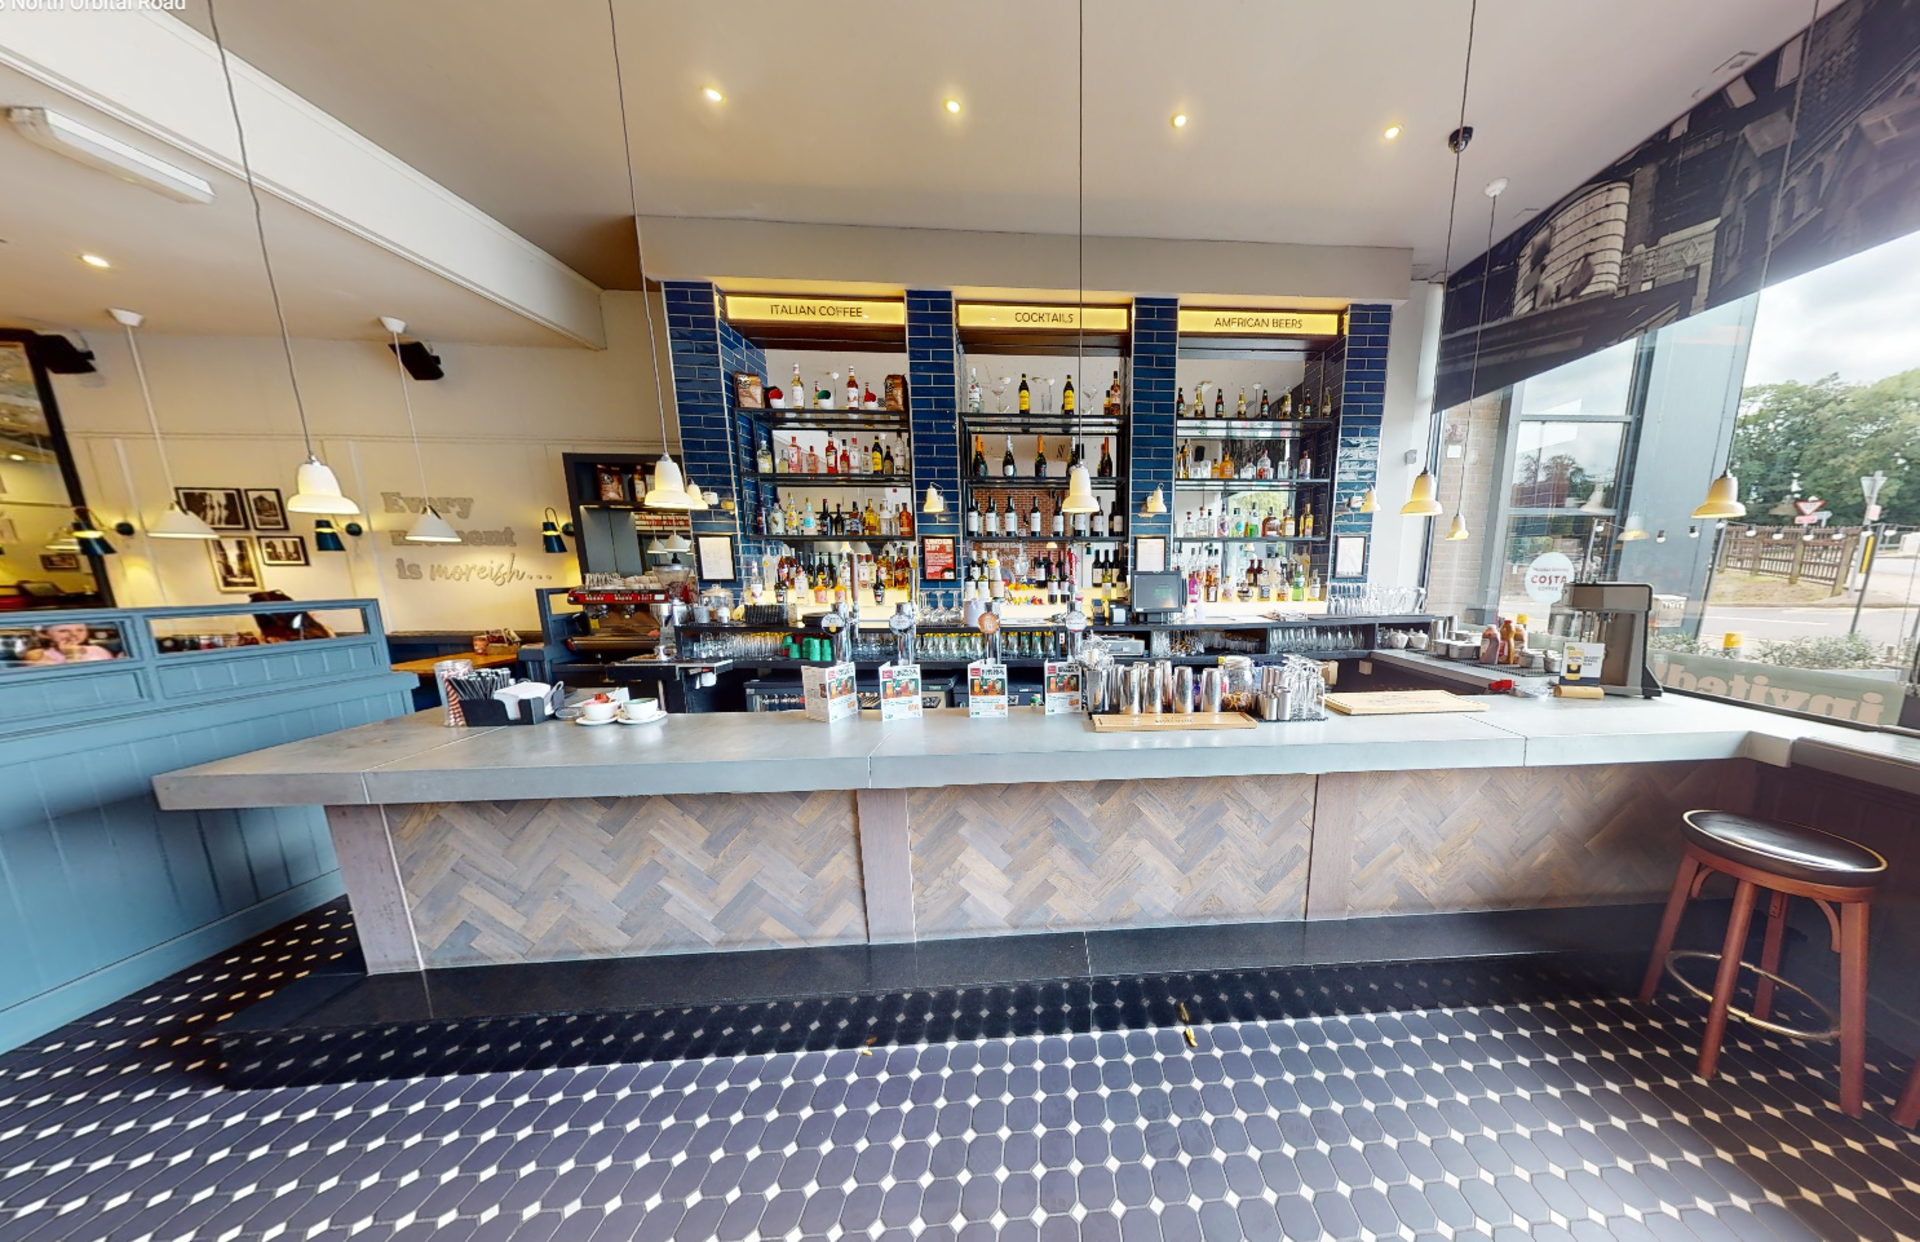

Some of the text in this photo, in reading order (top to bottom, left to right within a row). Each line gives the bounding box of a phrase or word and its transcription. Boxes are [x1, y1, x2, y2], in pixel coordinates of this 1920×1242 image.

[770, 304, 863, 318] ITALIAN COFFEE
[1015, 311, 1074, 324] COCKTAILS
[1214, 317, 1303, 329] AMERICAN BEERS
[380, 492, 474, 520] Every
[395, 557, 423, 580] is
[1531, 575, 1567, 586] COSTA
